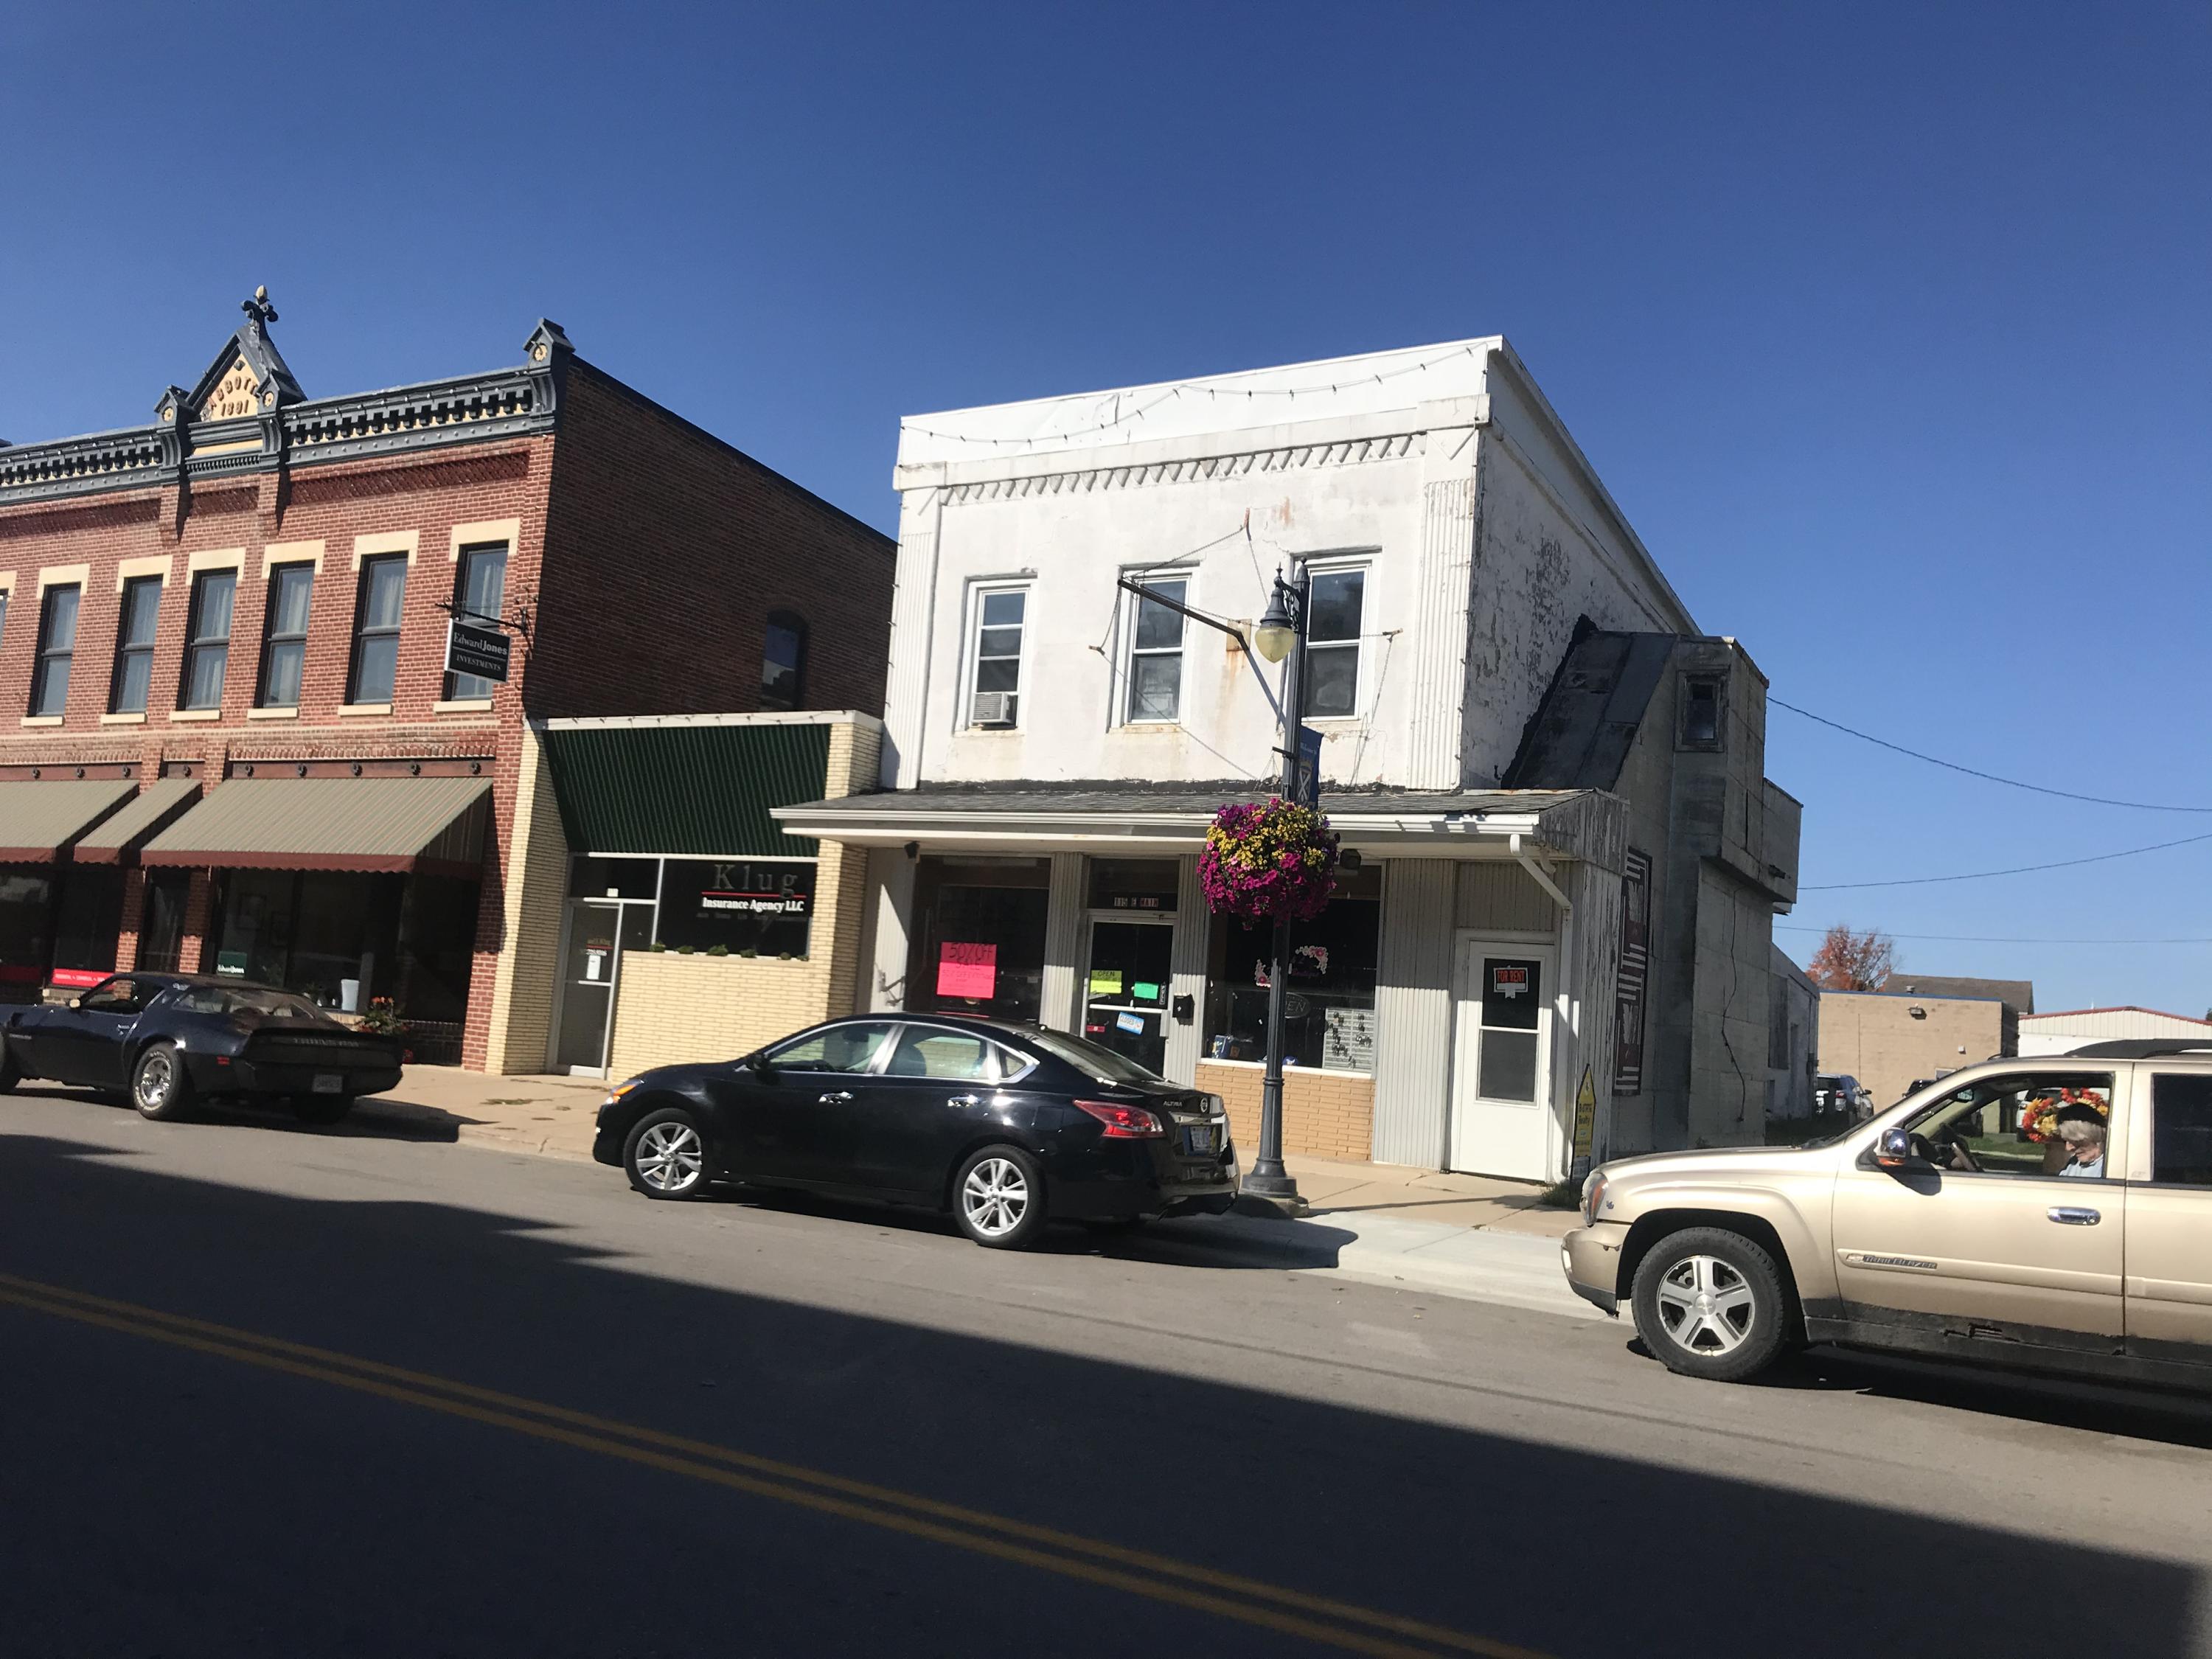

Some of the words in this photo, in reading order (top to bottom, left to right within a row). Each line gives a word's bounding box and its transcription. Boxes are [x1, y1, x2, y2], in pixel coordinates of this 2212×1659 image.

[456, 654, 501, 672] INVESTMENTS
[711, 863, 799, 900] Klug
[702, 897, 749, 909] Insurance
[749, 899, 785, 913] Agency
[785, 900, 805, 912] LLC
[1497, 970, 1509, 982] FOR
[1509, 970, 1525, 982] RENT
